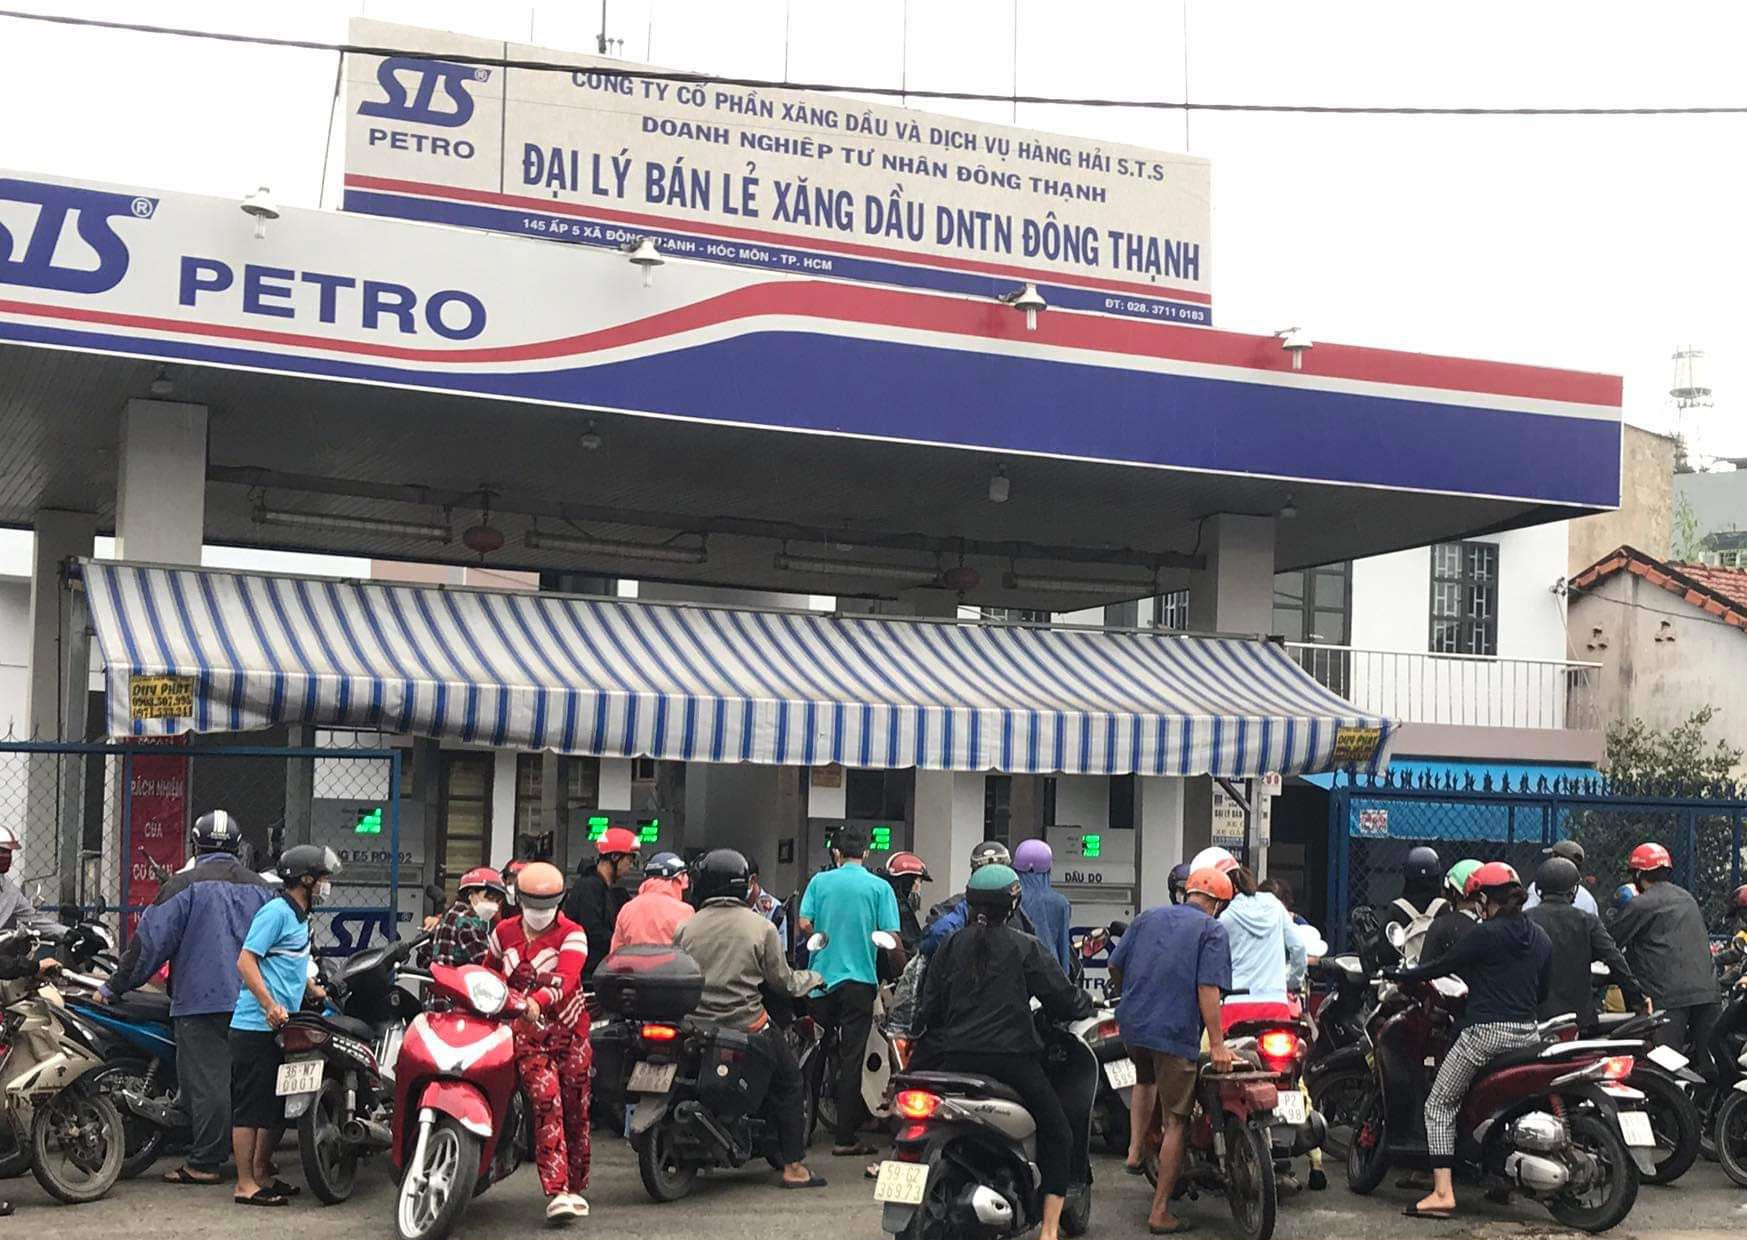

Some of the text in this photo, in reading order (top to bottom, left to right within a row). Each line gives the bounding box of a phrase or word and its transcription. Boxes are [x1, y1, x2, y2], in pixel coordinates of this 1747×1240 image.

[369, 128, 475, 159] PETRO
[641, 80, 669, 101] TY
[715, 90, 773, 118] PHẦN
[781, 102, 838, 128] XĂNG
[846, 109, 888, 137] DẦU
[896, 120, 921, 143] VÀ
[930, 127, 977, 151] DỊCH
[985, 136, 1010, 161] VỤ
[1018, 139, 1072, 166] HÀNG
[1078, 147, 1110, 172] HẢI
[1117, 158, 1164, 181] S.T.S
[642, 116, 729, 145] DOANH
[841, 147, 875, 167] TƯ
[882, 154, 948, 179] NHÂN
[957, 164, 1021, 190] ĐÔNG
[1029, 176, 1106, 202] THẠNH
[522, 142, 1199, 282] ĐẠI LÝ BÁN LẺ XĂNG DẦU DNTN ĐÔNG THẠNH
[523, 218, 546, 231] 145
[549, 218, 568, 234] ẤP
[572, 226, 580, 236] 5
[583, 226, 602, 240] XÃ
[707, 244, 736, 258] HÓC
[739, 248, 769, 263] MÔN
[780, 254, 801, 267] TP.
[804, 257, 833, 271] HCM
[179, 255, 487, 341] PETRO
[1127, 301, 1149, 313] 028.
[1152, 304, 1176, 317] 3711
[1179, 309, 1204, 321] 0183
[399, 851, 413, 865] 92
